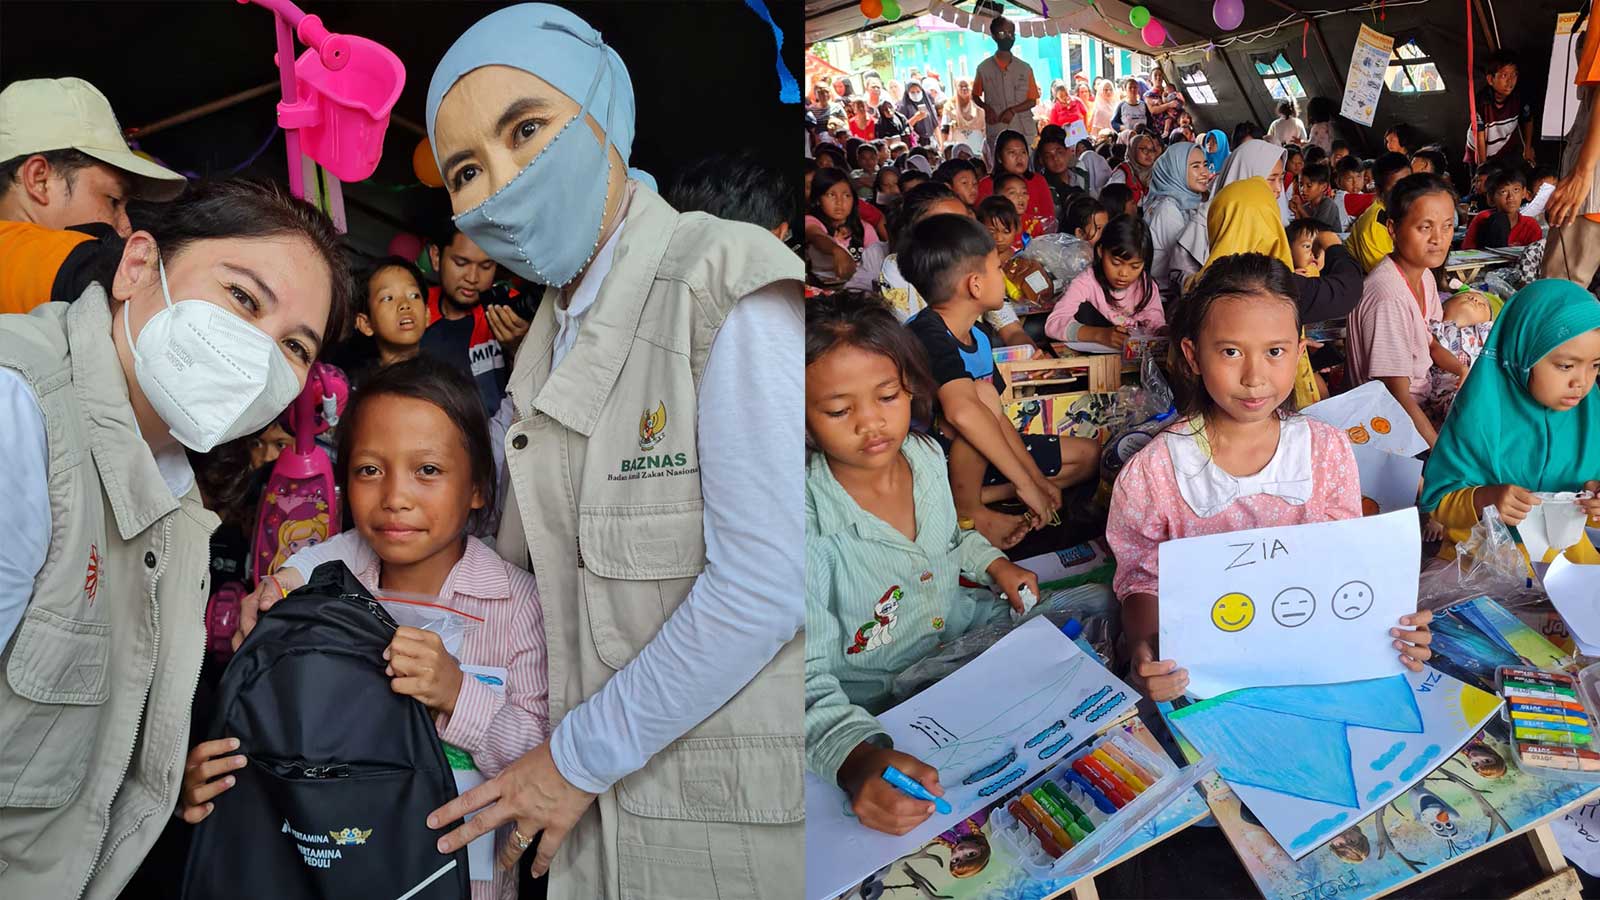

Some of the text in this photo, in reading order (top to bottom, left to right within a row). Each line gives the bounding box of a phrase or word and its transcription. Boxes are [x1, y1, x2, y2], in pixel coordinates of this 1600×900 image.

[621, 453, 687, 473] BAZNAS
[641, 471, 664, 479] Zakat
[303, 855, 330, 868] PEDULI
